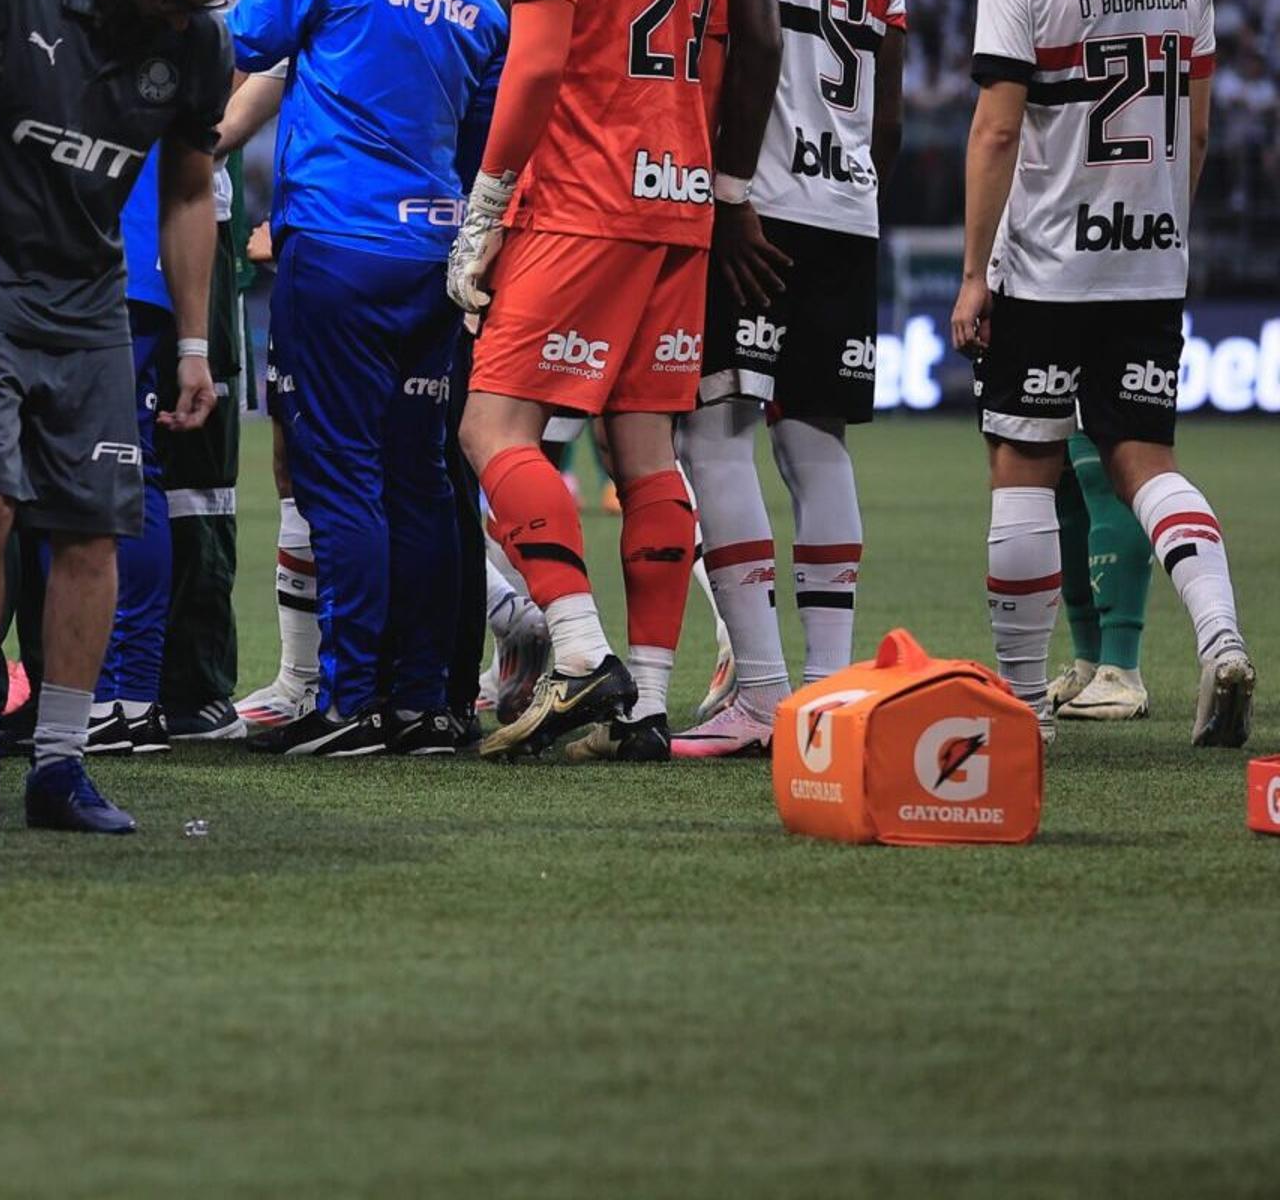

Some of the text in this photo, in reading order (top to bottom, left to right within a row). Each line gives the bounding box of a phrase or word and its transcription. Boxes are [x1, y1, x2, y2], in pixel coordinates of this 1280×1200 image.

[1082, 30, 1180, 167] 21
[541, 329, 609, 370] abc
[538, 360, 605, 380] da construção
[1120, 359, 1177, 398] abc
[1020, 394, 1034, 404] da
[1118, 389, 1132, 401] da
[790, 777, 843, 805] GATORADE
[898, 803, 1005, 824] GATORADE
